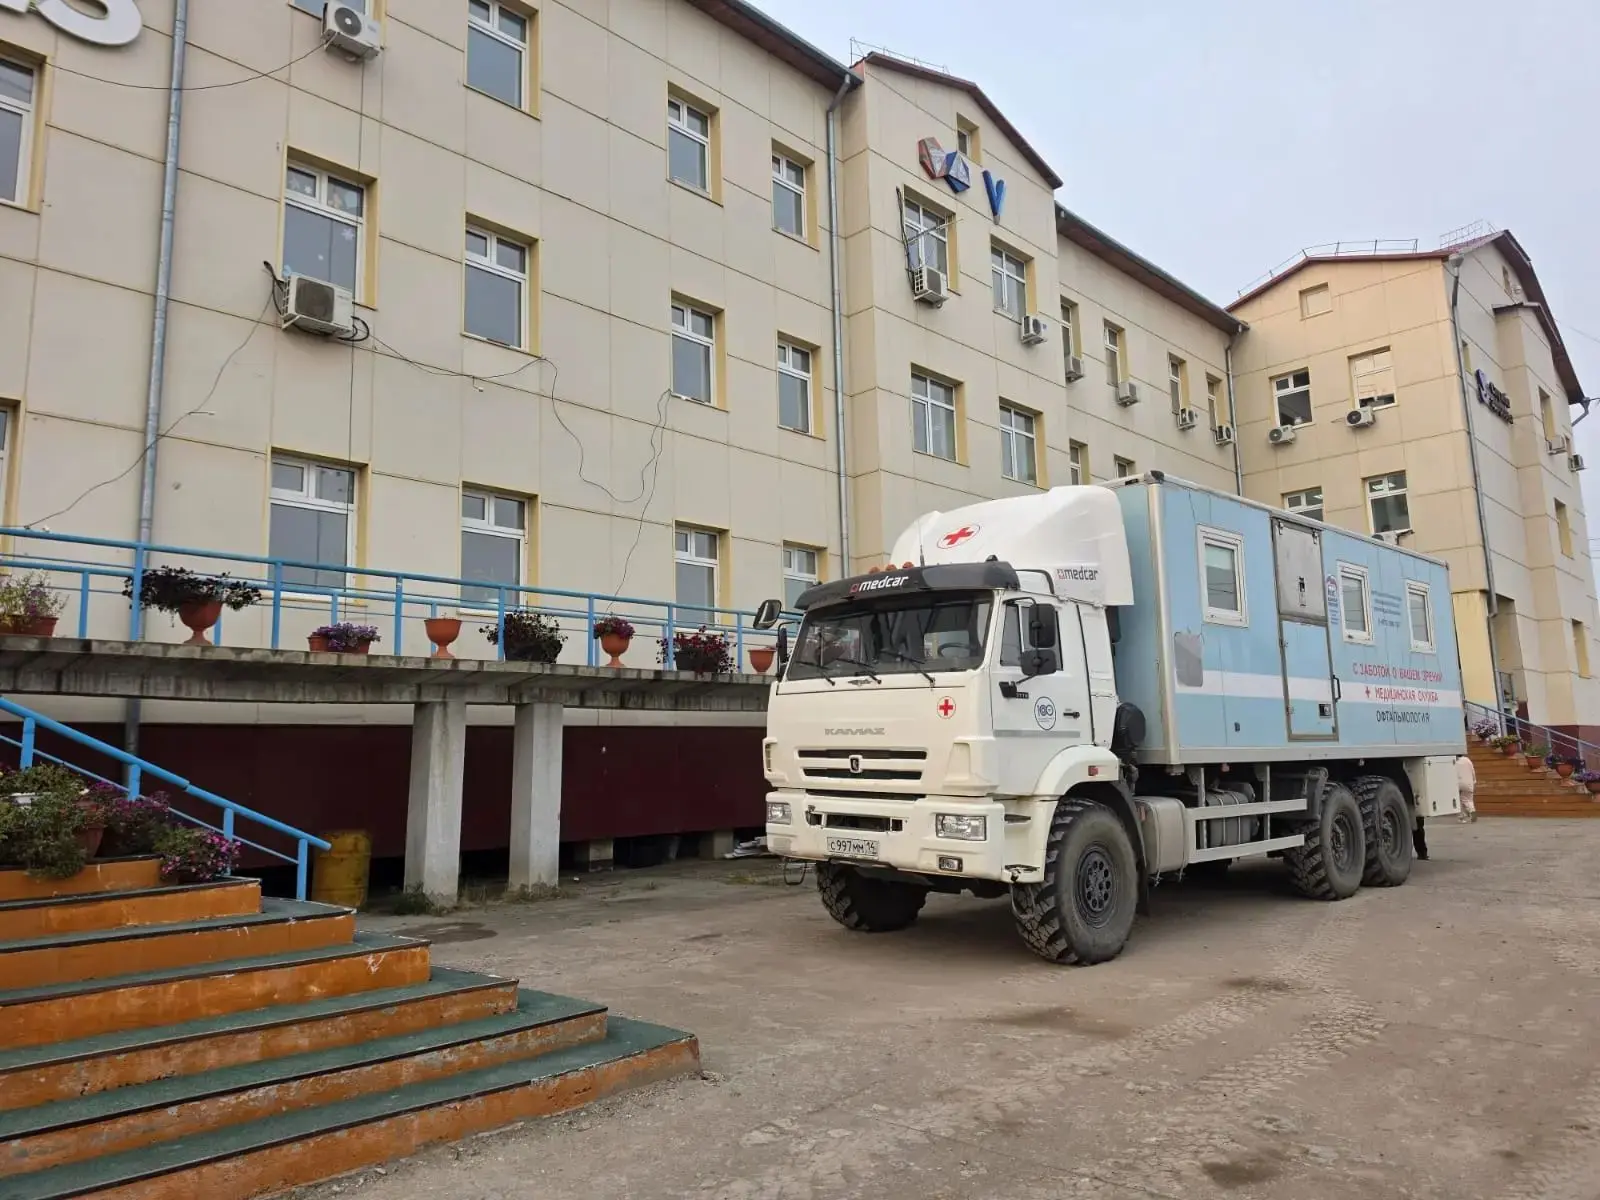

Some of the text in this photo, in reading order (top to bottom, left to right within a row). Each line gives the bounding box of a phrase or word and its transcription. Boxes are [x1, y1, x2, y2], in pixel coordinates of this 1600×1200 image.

[1064, 567, 1099, 581] medcar
[858, 575, 909, 592] medcar
[1375, 686, 1416, 702] МЕДИЦИНСКАЯ
[1376, 710, 1430, 723] ОФТАЛЬМОЛОГИЯ
[824, 727, 887, 736] KAMAZ
